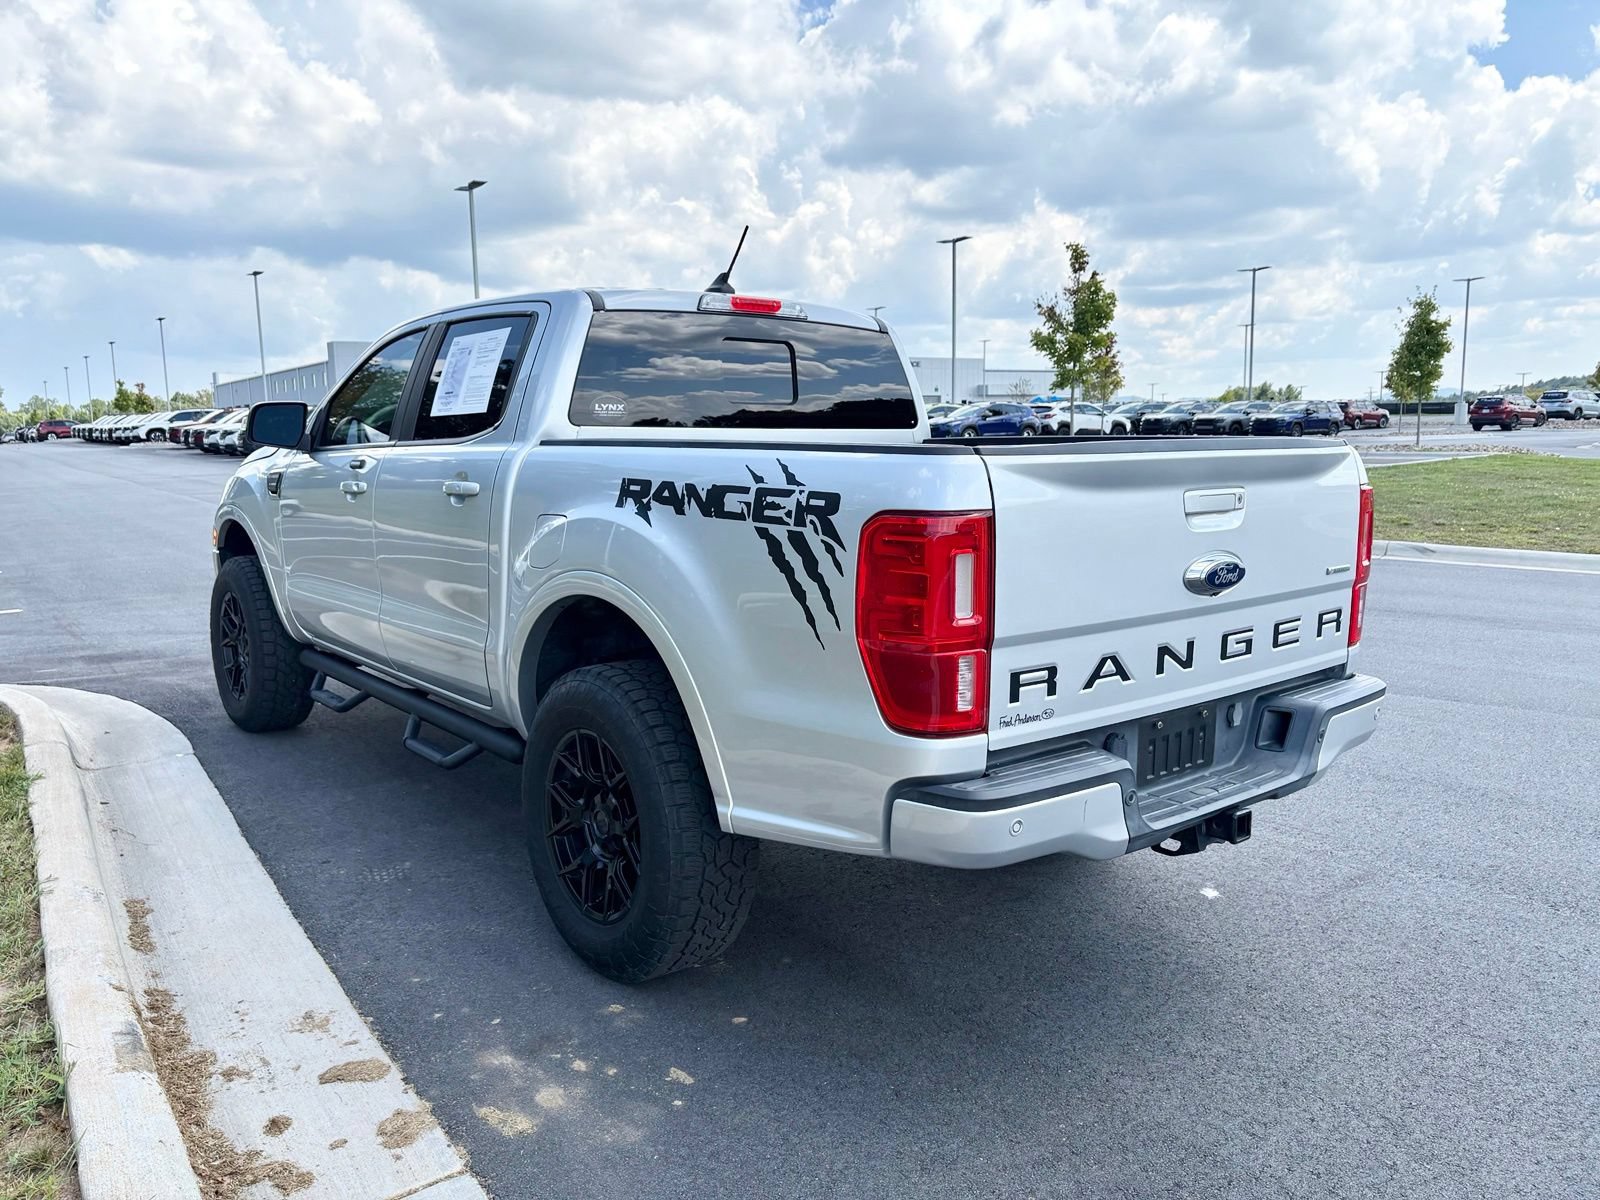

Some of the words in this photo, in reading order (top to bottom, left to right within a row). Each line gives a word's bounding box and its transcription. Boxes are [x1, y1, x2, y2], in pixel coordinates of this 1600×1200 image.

[594, 403, 625, 411] LYNX
[615, 477, 846, 552] RANGER
[1214, 565, 1239, 585] Ford
[1008, 607, 1343, 705] RANGER
[1014, 713, 1042, 727] Anderson
